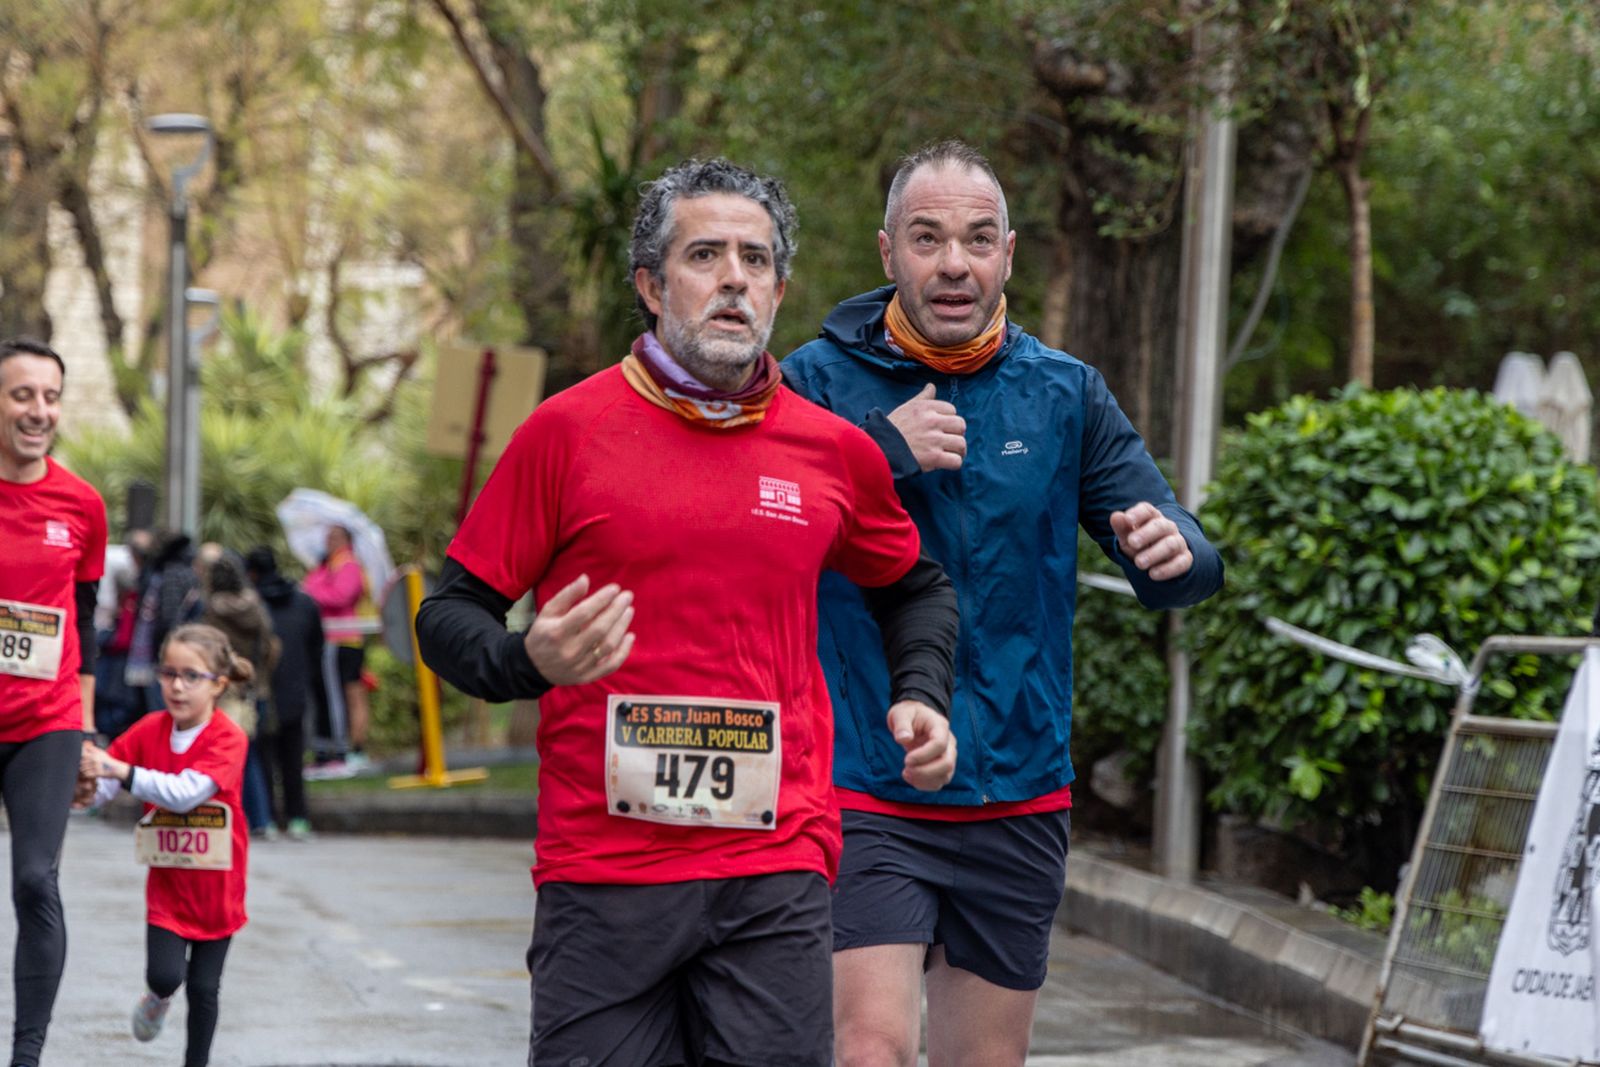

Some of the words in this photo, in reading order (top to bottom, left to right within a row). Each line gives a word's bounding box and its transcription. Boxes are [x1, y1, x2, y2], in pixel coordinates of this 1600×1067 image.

[654, 706, 682, 724] San
[686, 708, 721, 725] Juan
[725, 711, 764, 727] Bosco
[622, 726, 632, 743] V
[636, 726, 703, 746] CARRERA
[708, 729, 768, 750] POPULAR
[655, 753, 735, 801] 479
[157, 829, 209, 854] 1020
